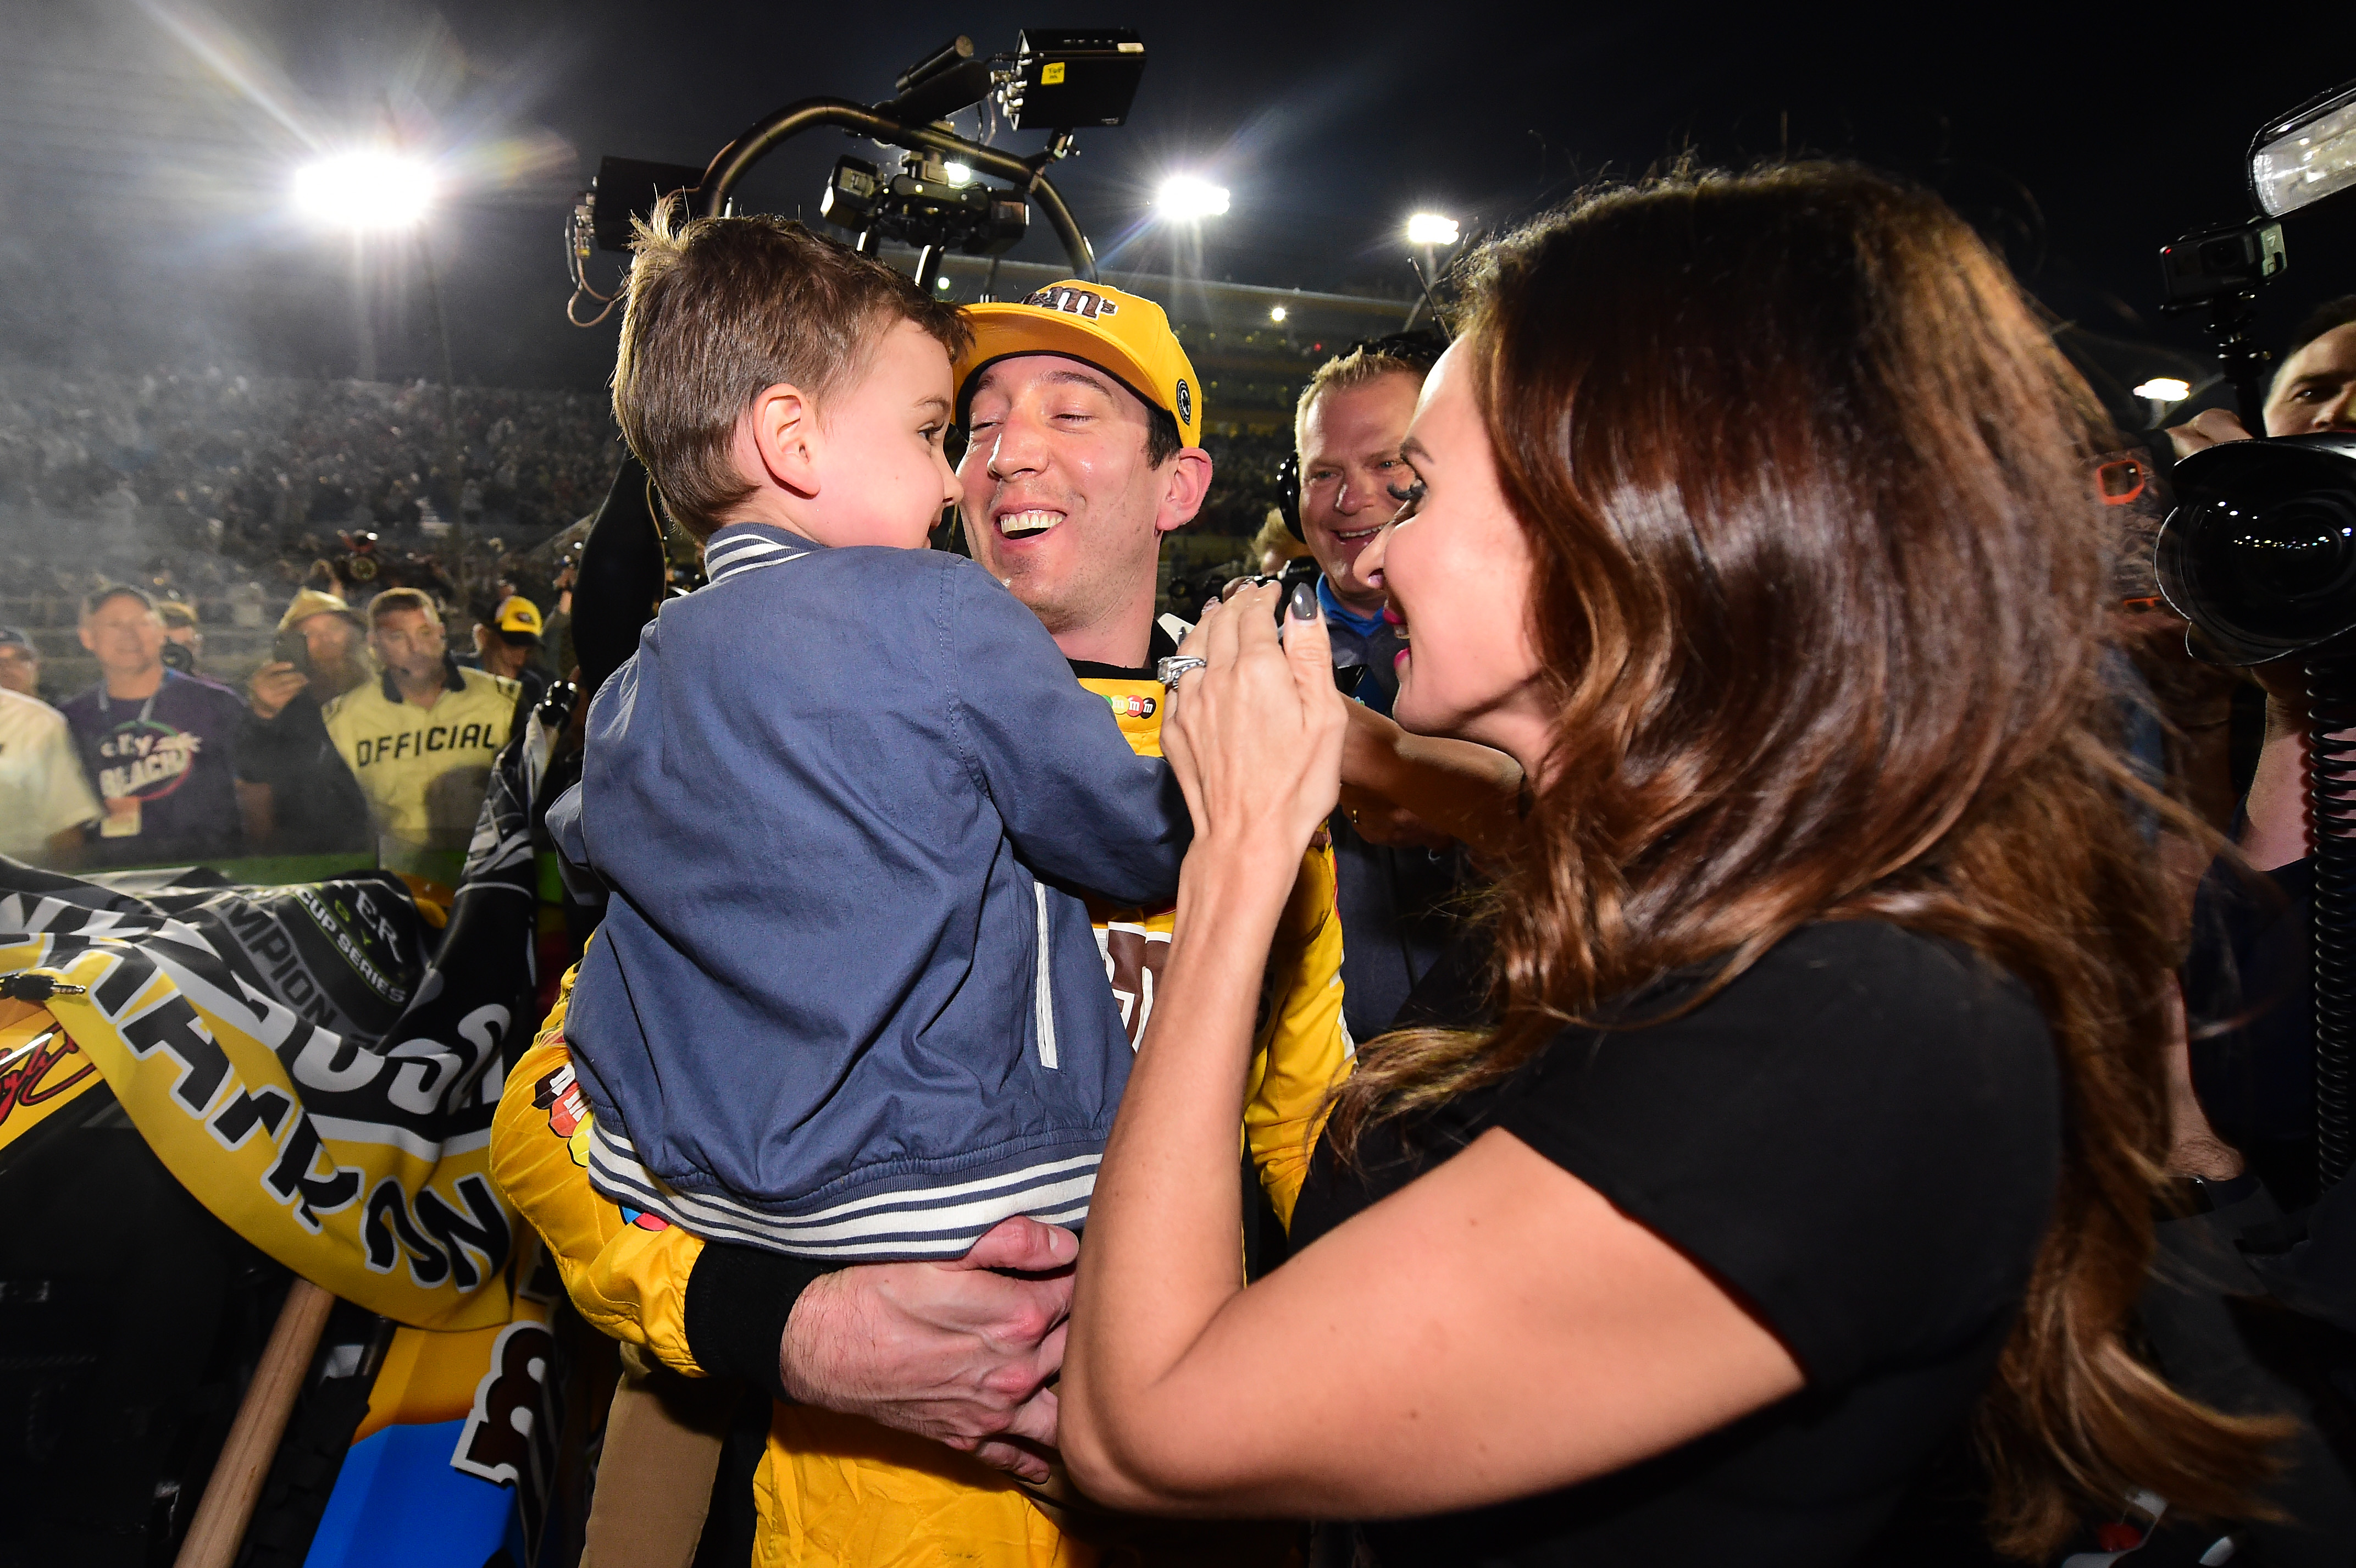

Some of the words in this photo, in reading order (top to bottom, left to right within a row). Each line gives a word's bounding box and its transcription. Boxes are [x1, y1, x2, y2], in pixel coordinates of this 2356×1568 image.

[1128, 701, 1140, 711] m
[1143, 703, 1153, 713] m
[357, 723, 494, 767] OFFICIAL
[296, 888, 337, 932] CUP
[337, 933, 407, 1003] SERIES
